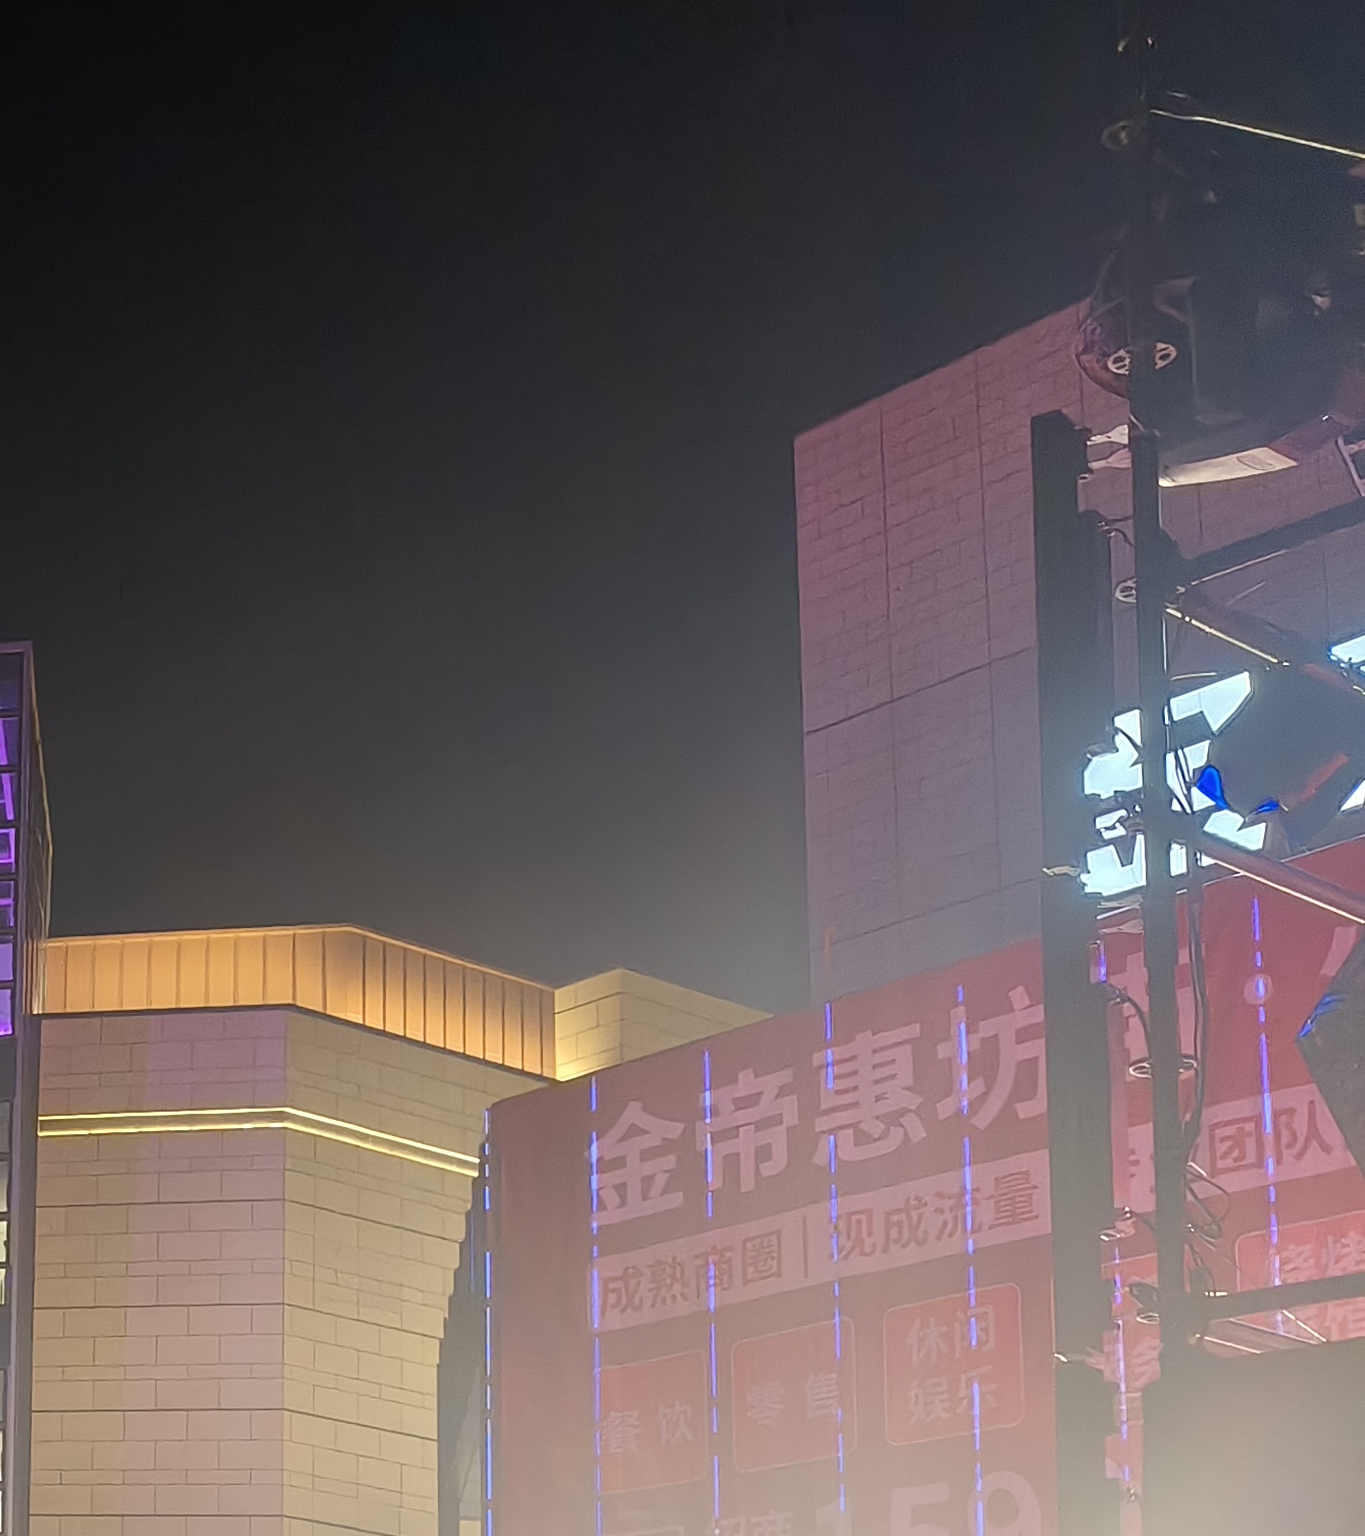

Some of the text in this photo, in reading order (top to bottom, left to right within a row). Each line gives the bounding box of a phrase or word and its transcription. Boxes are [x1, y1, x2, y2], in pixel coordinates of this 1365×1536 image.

[586, 985, 1047, 1228] 金帝惠坊
[601, 1170, 1040, 1318] 成熟商圈 现成流量
[905, 1303, 996, 1365] 休闲
[746, 1371, 842, 1429] 零售
[906, 1365, 999, 1426] 娱乐
[601, 1400, 694, 1455] 餐饮
